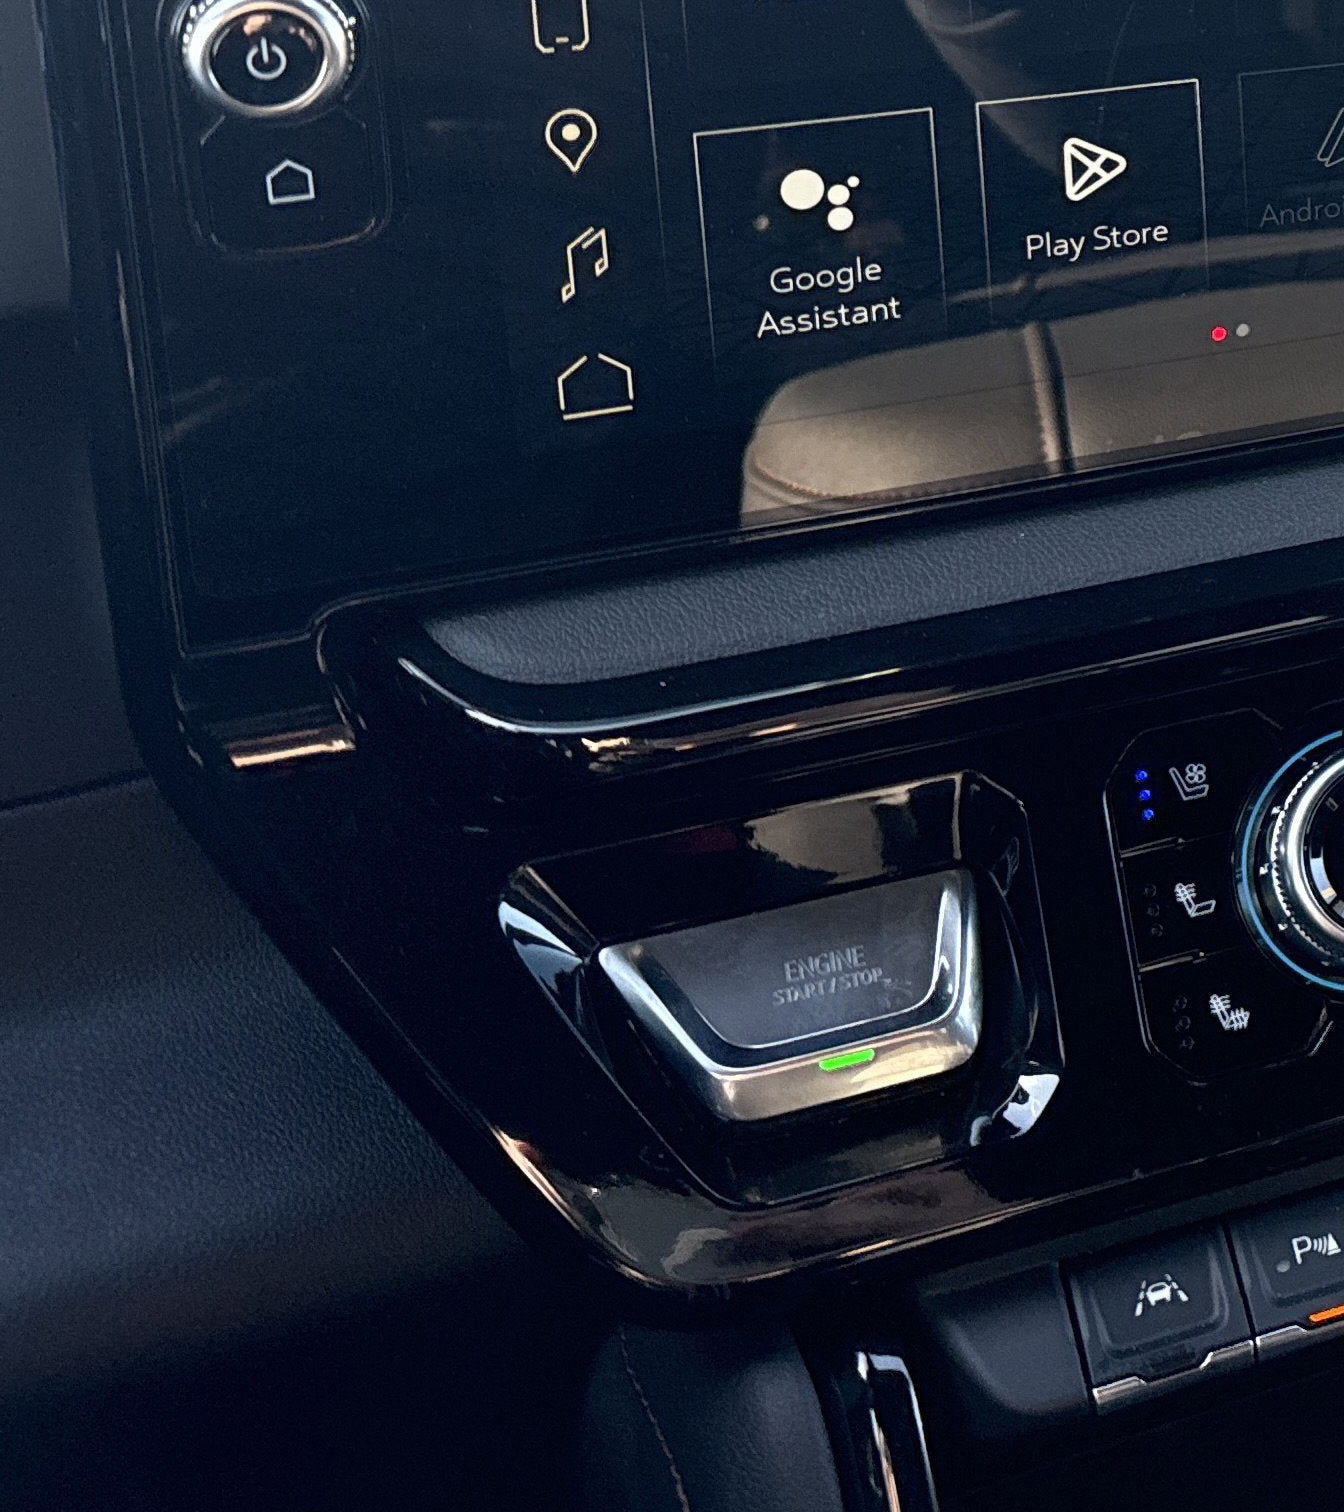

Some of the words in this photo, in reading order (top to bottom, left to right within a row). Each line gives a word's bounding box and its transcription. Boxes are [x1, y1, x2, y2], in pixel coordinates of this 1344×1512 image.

[1025, 231, 1086, 263] Play
[1093, 221, 1169, 251] Store
[769, 256, 883, 293] Google
[757, 297, 902, 338] Assistant
[783, 945, 867, 983] ENGINE
